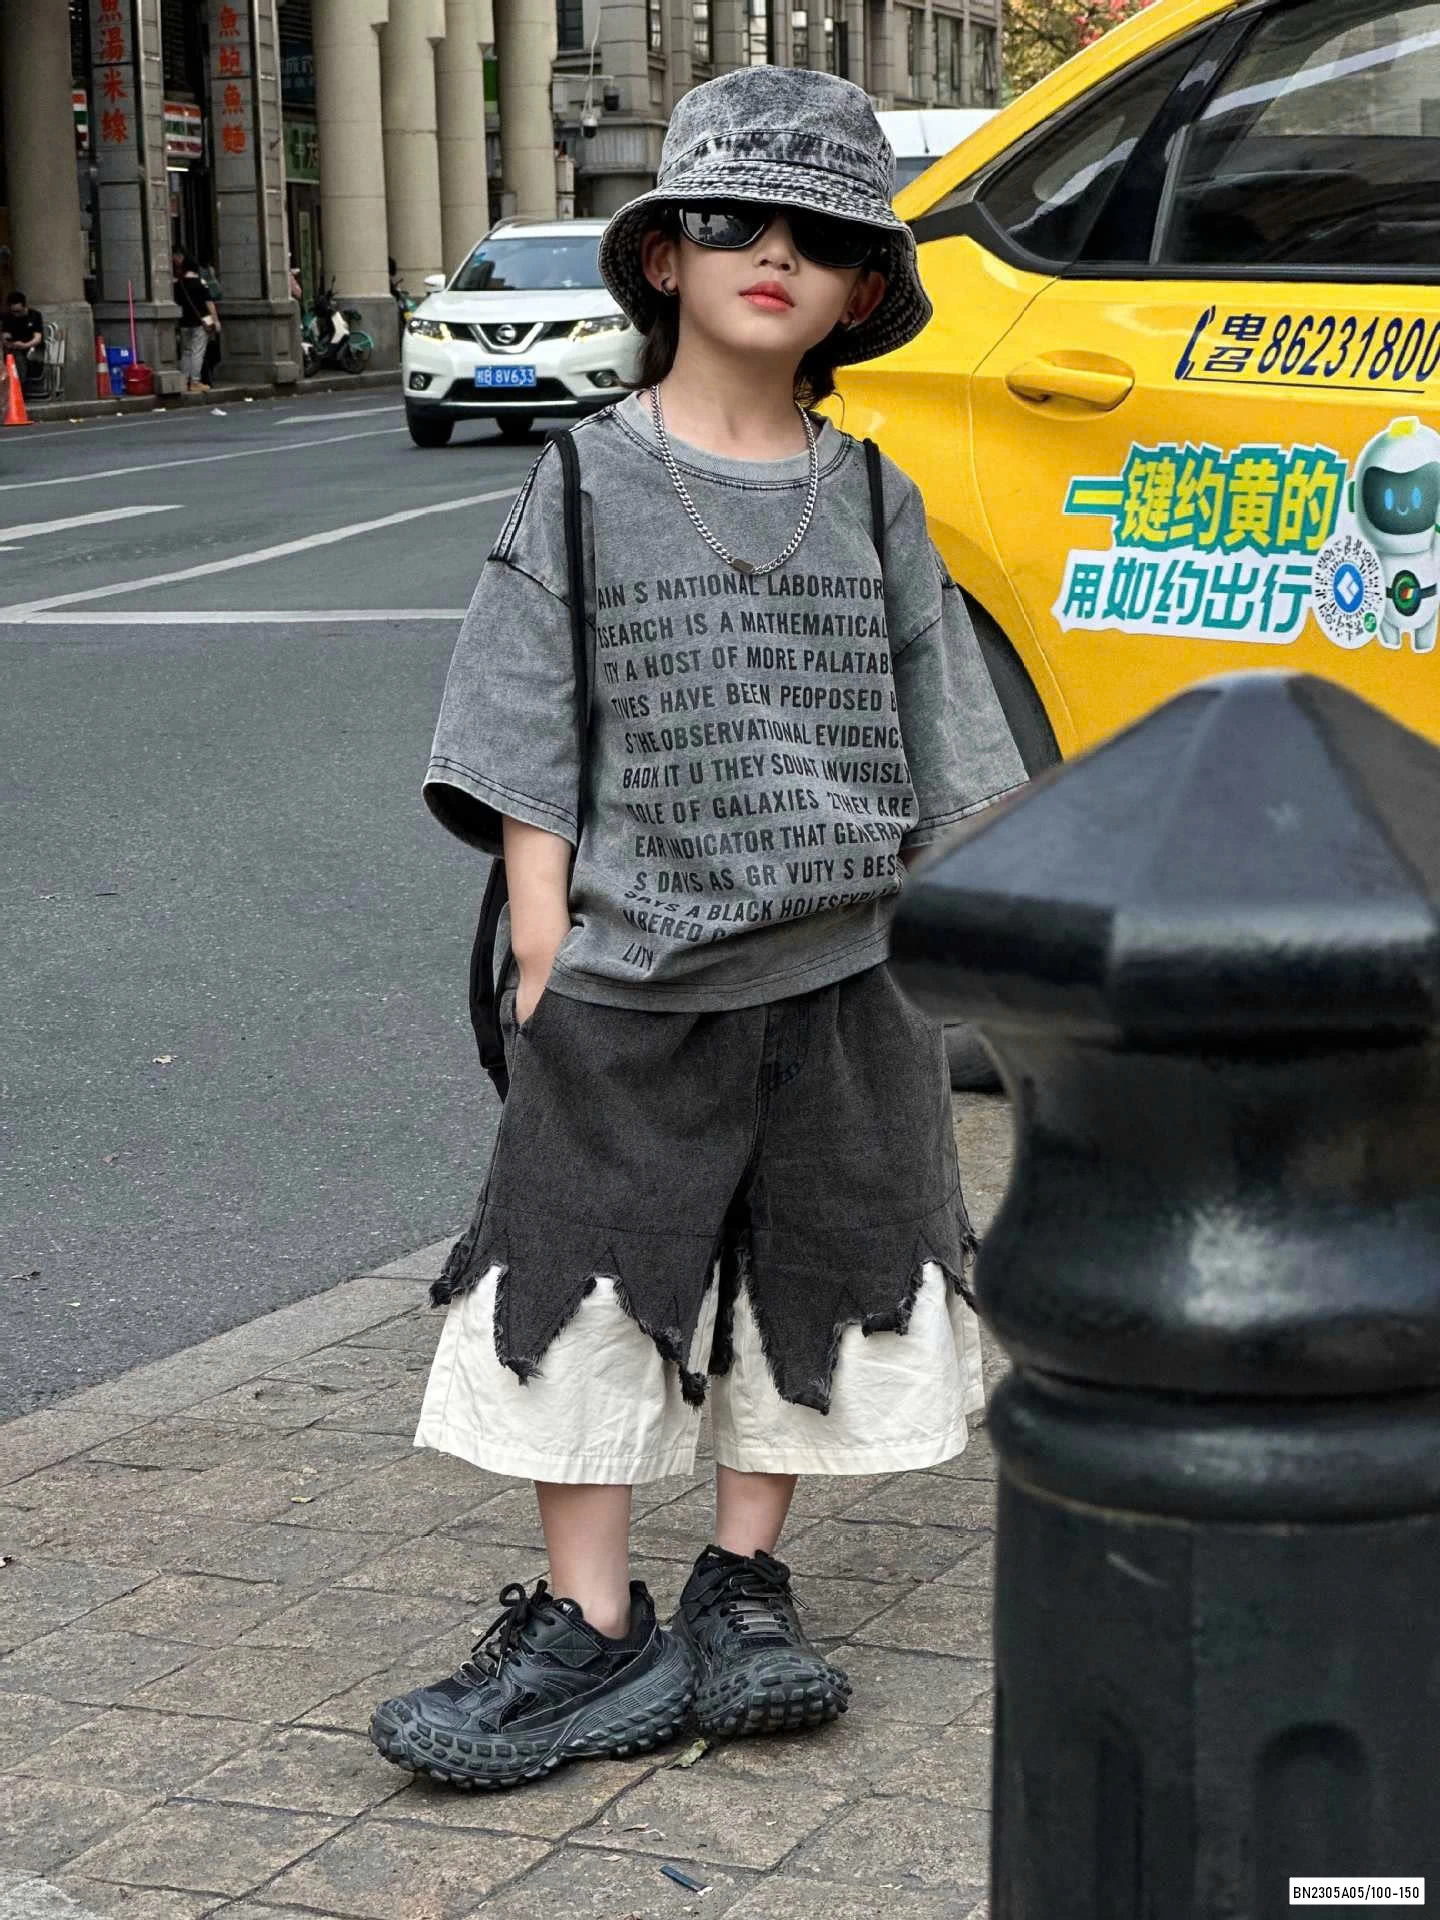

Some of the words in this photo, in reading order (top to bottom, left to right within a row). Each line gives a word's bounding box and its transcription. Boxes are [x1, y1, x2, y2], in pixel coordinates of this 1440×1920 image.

[1257, 314, 1440, 383] 86231800
[1070, 455, 1337, 551] 一键约黄的
[634, 581, 649, 605] S
[657, 574, 760, 601] NATIONAL
[767, 575, 883, 599] LABORATOR
[1062, 556, 1313, 634] 用如约出行
[686, 613, 708, 636] IS
[720, 611, 734, 634] A
[741, 611, 888, 638] MATHEMATICAL
[626, 660, 638, 681] A
[644, 649, 701, 678] HOST
[712, 646, 738, 670] OF
[747, 646, 798, 670] MORE
[660, 686, 715, 713] HAVE
[726, 683, 771, 706] BEEN
[780, 685, 882, 712] PEOPOSED
[661, 718, 812, 751] OBSERVATIONAL
[815, 724, 903, 750] EVIDENC
[664, 765, 680, 787] IT
[689, 762, 704, 784] U
[710, 753, 764, 782] THEY
[672, 800, 700, 824] OF
[713, 788, 819, 819] GALAXIES
[877, 797, 915, 817] ARE
[779, 823, 827, 849] THAT
[634, 871, 647, 891] S
[658, 871, 703, 893] DAYS
[710, 867, 734, 890] AS
[843, 858, 854, 880] S
[685, 905, 701, 918] A
[707, 900, 773, 922] BLACK
